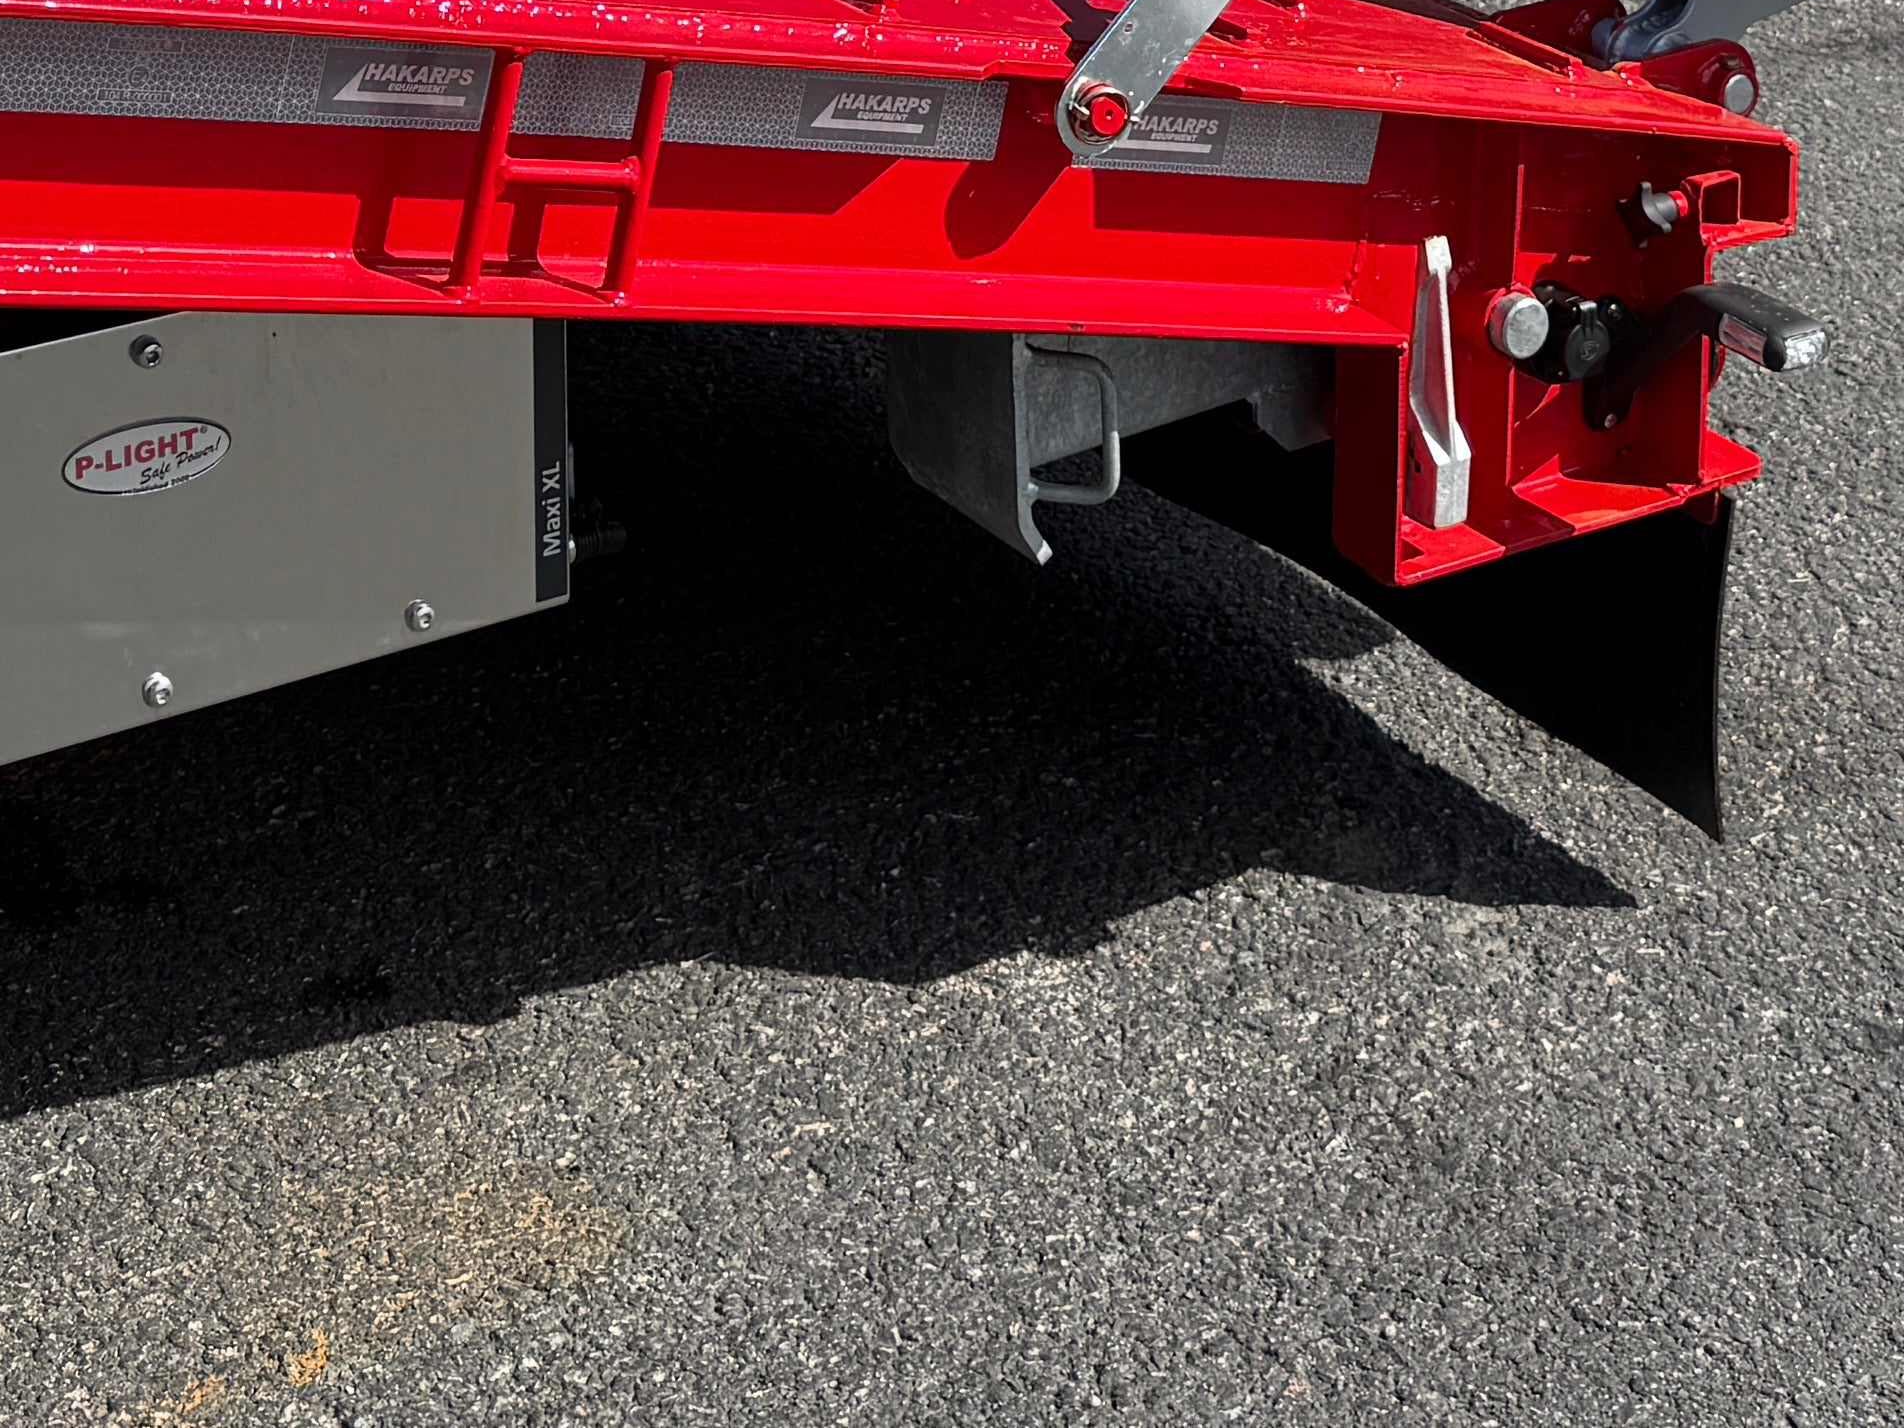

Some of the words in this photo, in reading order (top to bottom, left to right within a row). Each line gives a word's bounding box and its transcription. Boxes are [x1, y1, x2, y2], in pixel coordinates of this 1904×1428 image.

[364, 63, 475, 86] HAKARPS
[388, 82, 448, 94] EQUIPMENT
[837, 92, 932, 115] HAKARPS
[857, 110, 909, 122] EQUIPMENT
[1133, 115, 1220, 135] HAKARPS
[140, 460, 171, 485] Safe
[175, 435, 222, 467] Power!
[542, 460, 561, 493] XL
[542, 496, 561, 557] Maxi
